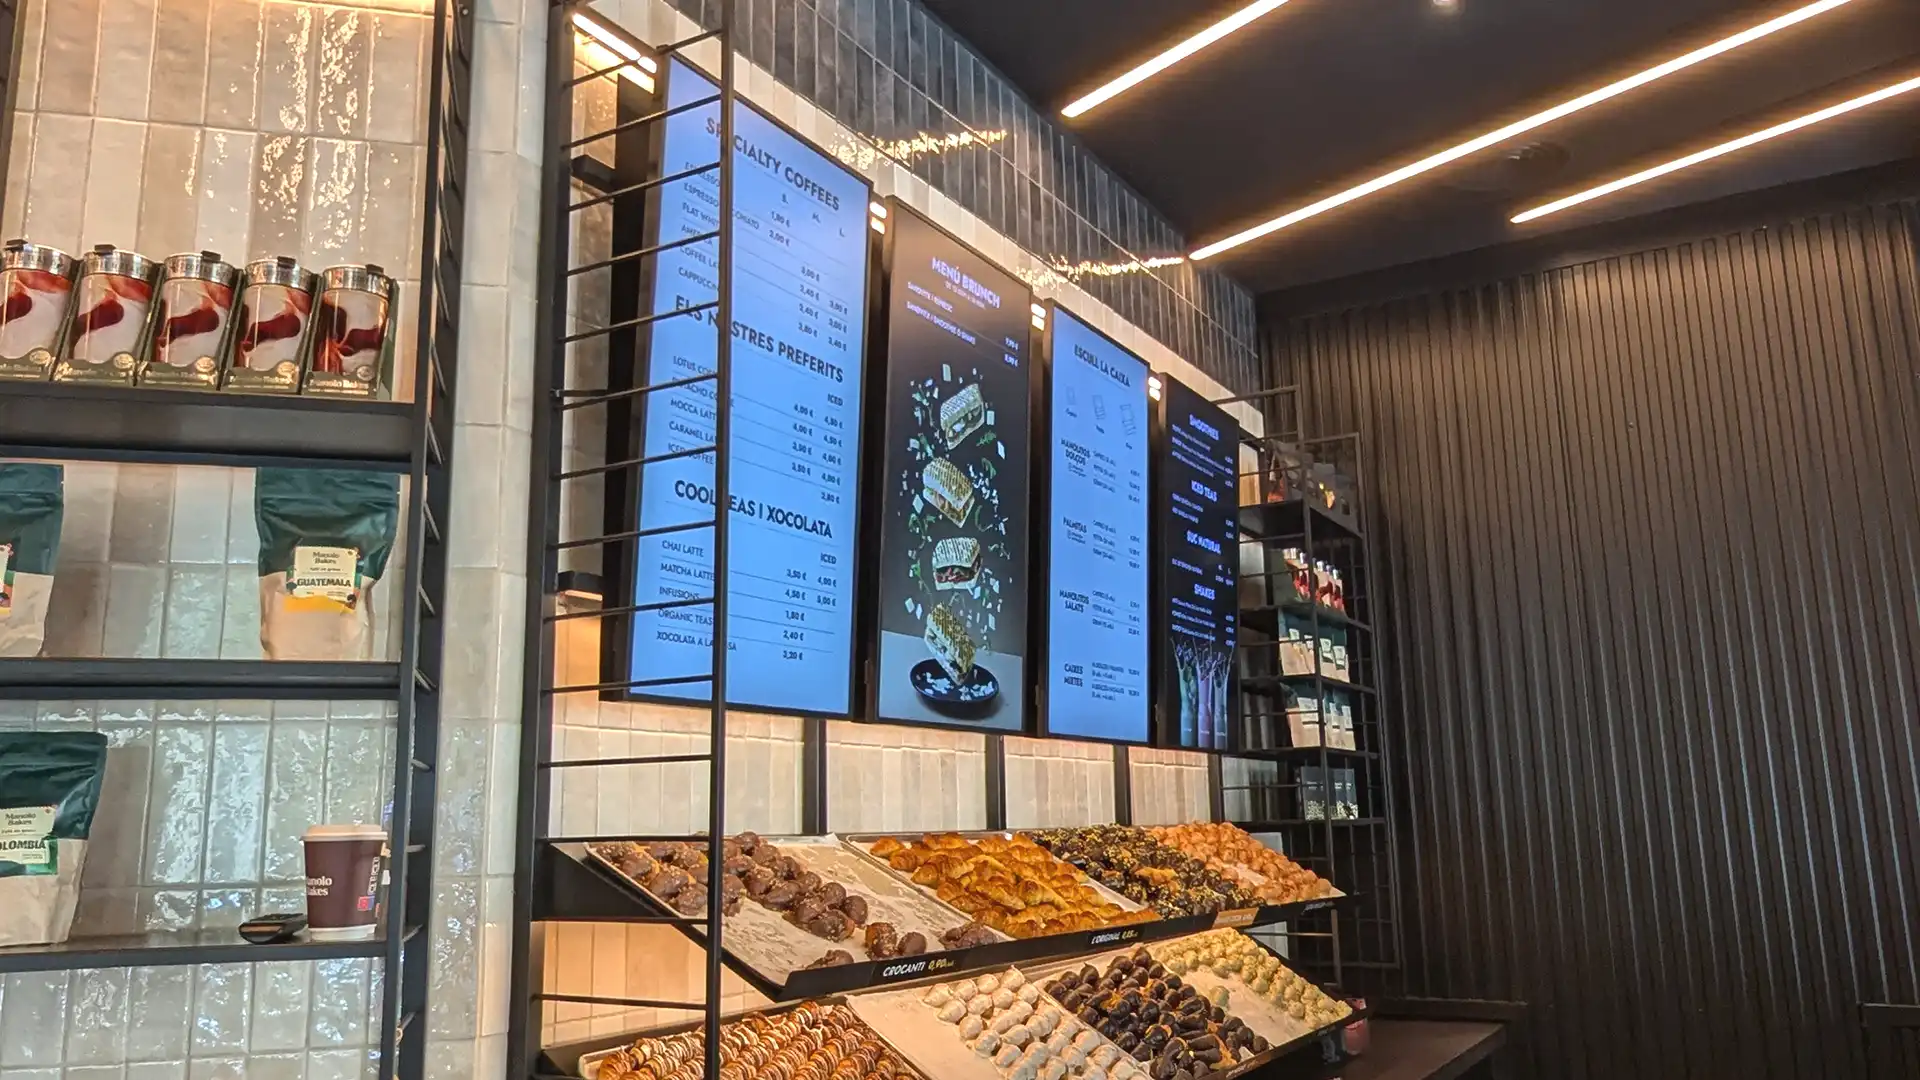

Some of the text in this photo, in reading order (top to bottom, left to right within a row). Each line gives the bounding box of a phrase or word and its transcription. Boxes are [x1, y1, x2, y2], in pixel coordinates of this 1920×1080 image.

[785, 166, 840, 211] COFFEES
[682, 202, 700, 217] FLAT
[962, 273, 1000, 309] BRUNCH
[673, 355, 696, 371] LOTUS
[778, 341, 843, 383] PREFERITS
[1100, 360, 1109, 375] LA
[1110, 367, 1130, 388] CAIXA
[671, 398, 699, 415] MOCCA
[827, 393, 843, 406] ICED
[669, 420, 703, 440] CARAMEL
[729, 495, 756, 517] EAS
[767, 505, 833, 538] XOCOLATA
[662, 540, 681, 552] CHAI
[682, 544, 704, 557] LATTE
[821, 552, 836, 564] ICED
[297, 578, 351, 588] GUATEMALA
[660, 563, 692, 576] MATCHA
[785, 589, 800, 600] 4,50
[660, 586, 700, 600] INFUSIONS
[658, 609, 693, 623] ORGANIC
[695, 614, 713, 626] TEAS
[783, 630, 798, 640] 2,40
[657, 631, 696, 645] XOCOLATA
[698, 637, 703, 646] A
[883, 961, 926, 977] CROCANTI
